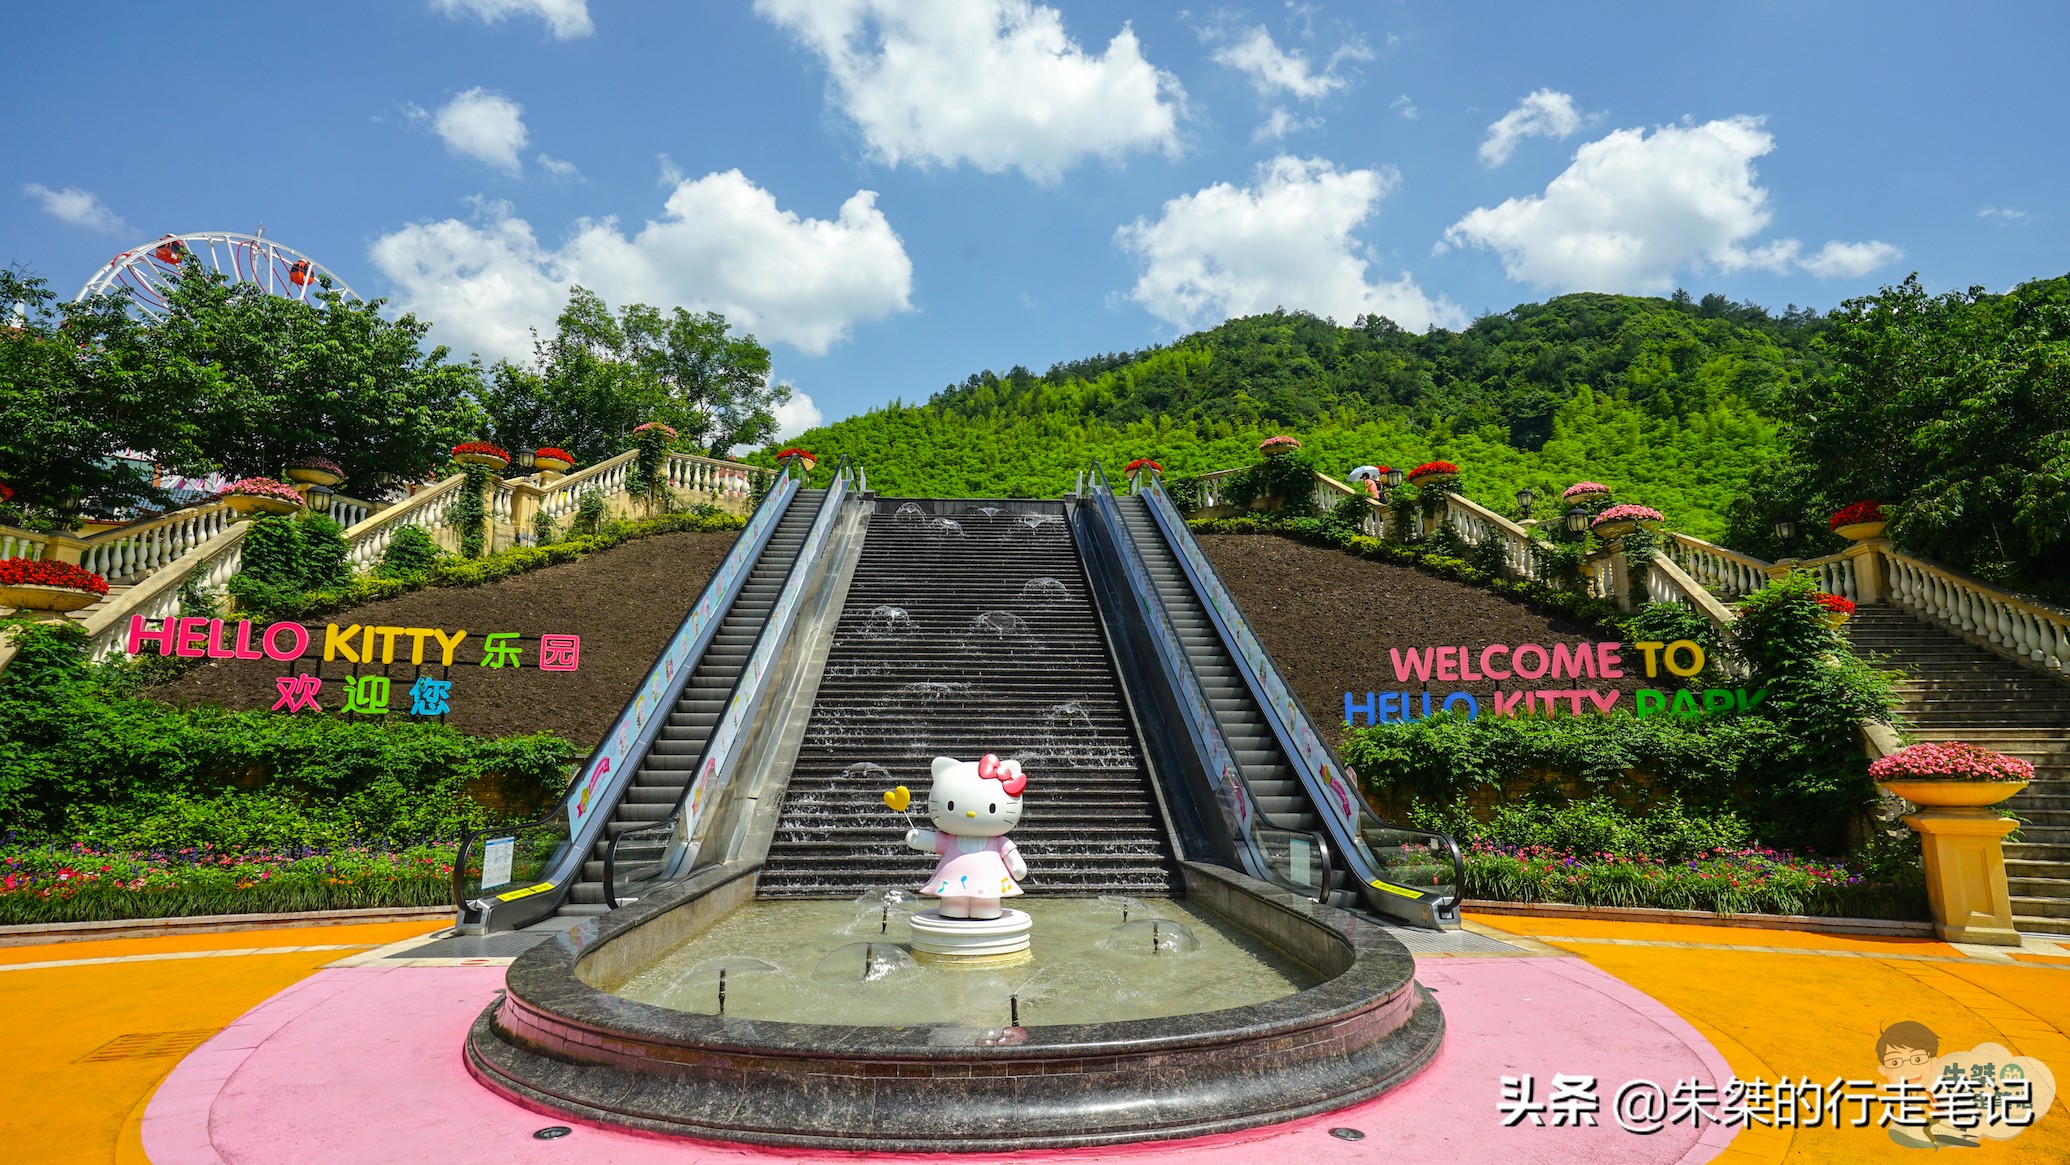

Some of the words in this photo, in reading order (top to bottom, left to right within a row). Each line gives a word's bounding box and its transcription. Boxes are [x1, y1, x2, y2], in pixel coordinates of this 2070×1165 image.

[127, 613, 311, 662] HELLO
[323, 622, 468, 667] KITTY
[480, 631, 581, 672] 乐园
[1390, 641, 1624, 682] WELCOME
[1634, 639, 1706, 679] TO
[271, 672, 452, 715] 欢迎您
[1344, 691, 1479, 726] HELLO
[1494, 689, 1620, 719] KITTY
[1635, 688, 1769, 720] PARK
